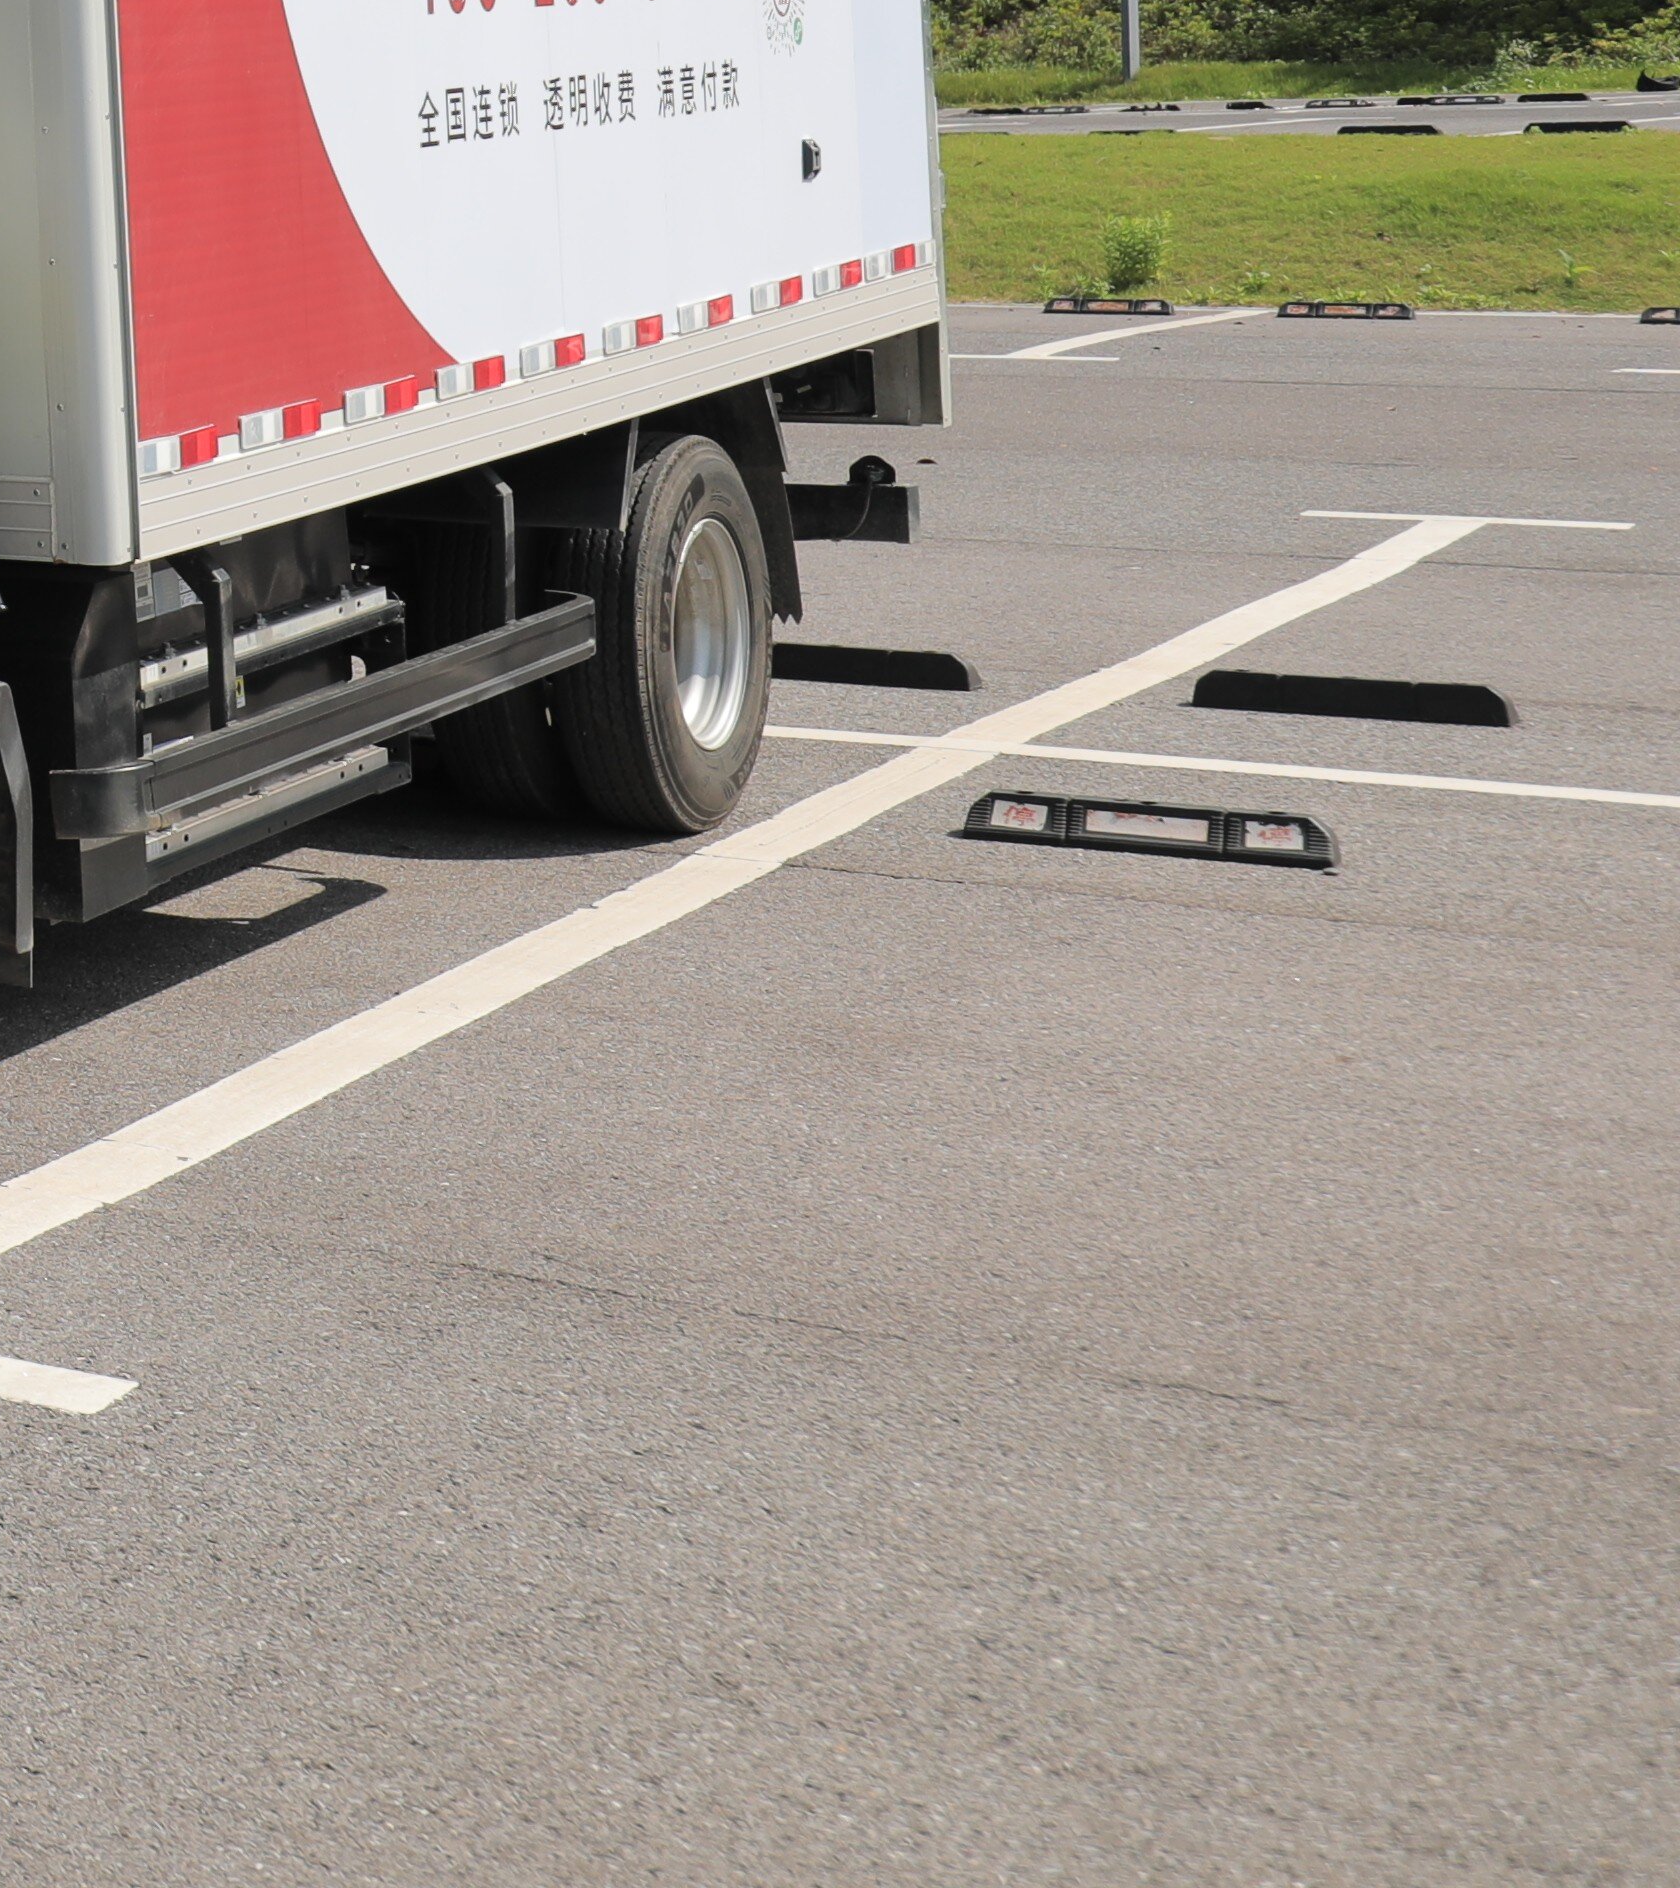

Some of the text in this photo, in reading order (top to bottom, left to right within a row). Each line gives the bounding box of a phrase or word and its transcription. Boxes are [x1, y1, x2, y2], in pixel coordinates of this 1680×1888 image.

[418, 58, 740, 148] 全国连锁 透明收费 满意付款
